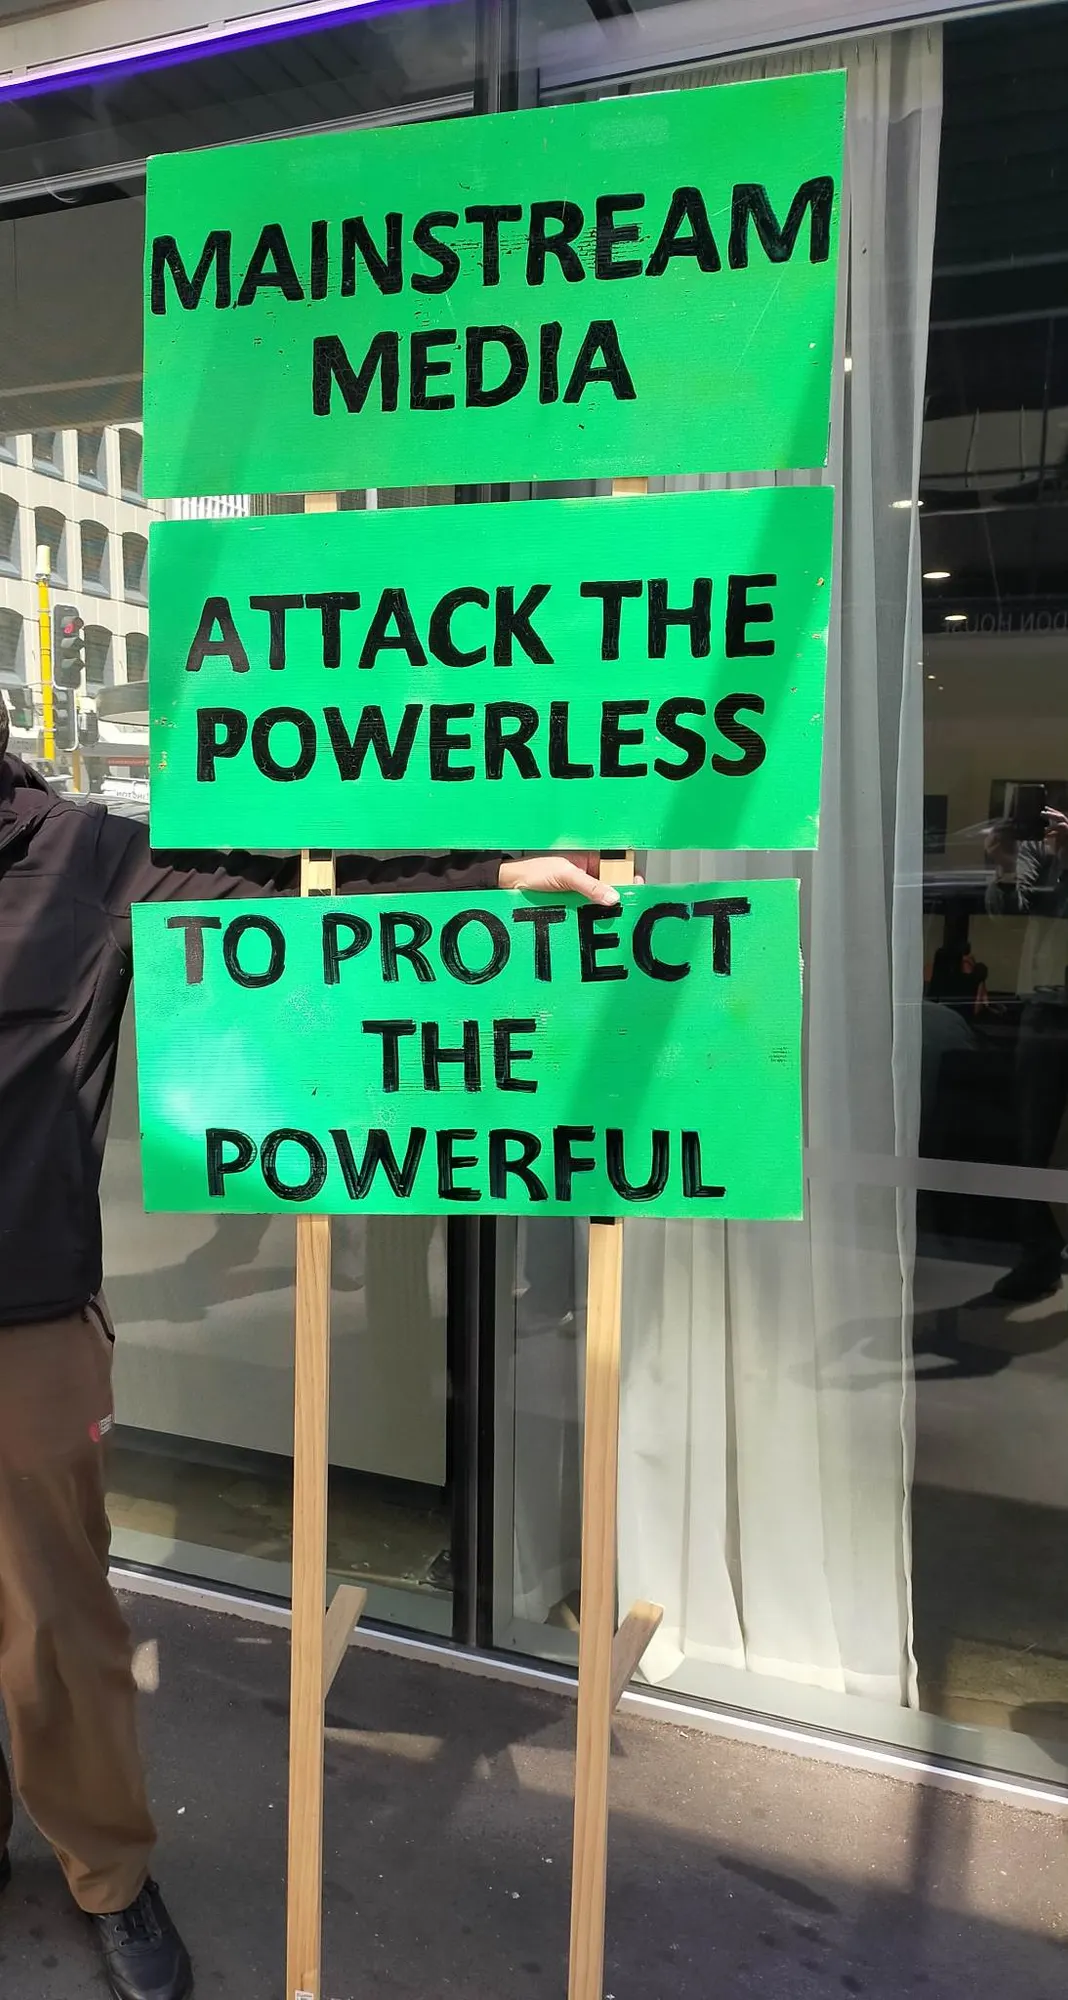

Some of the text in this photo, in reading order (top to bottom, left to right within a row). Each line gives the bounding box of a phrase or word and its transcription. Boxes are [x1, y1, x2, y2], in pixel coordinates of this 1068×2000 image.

[150, 176, 834, 315] MAINSTREAM
[312, 320, 637, 416] MEDIA
[186, 574, 777, 673] ATTACK THE
[196, 693, 767, 782] POWERLESS
[168, 897, 750, 988] TO PROTECT
[362, 1019, 538, 1093] THE
[205, 1125, 726, 1202] POWERFUL
